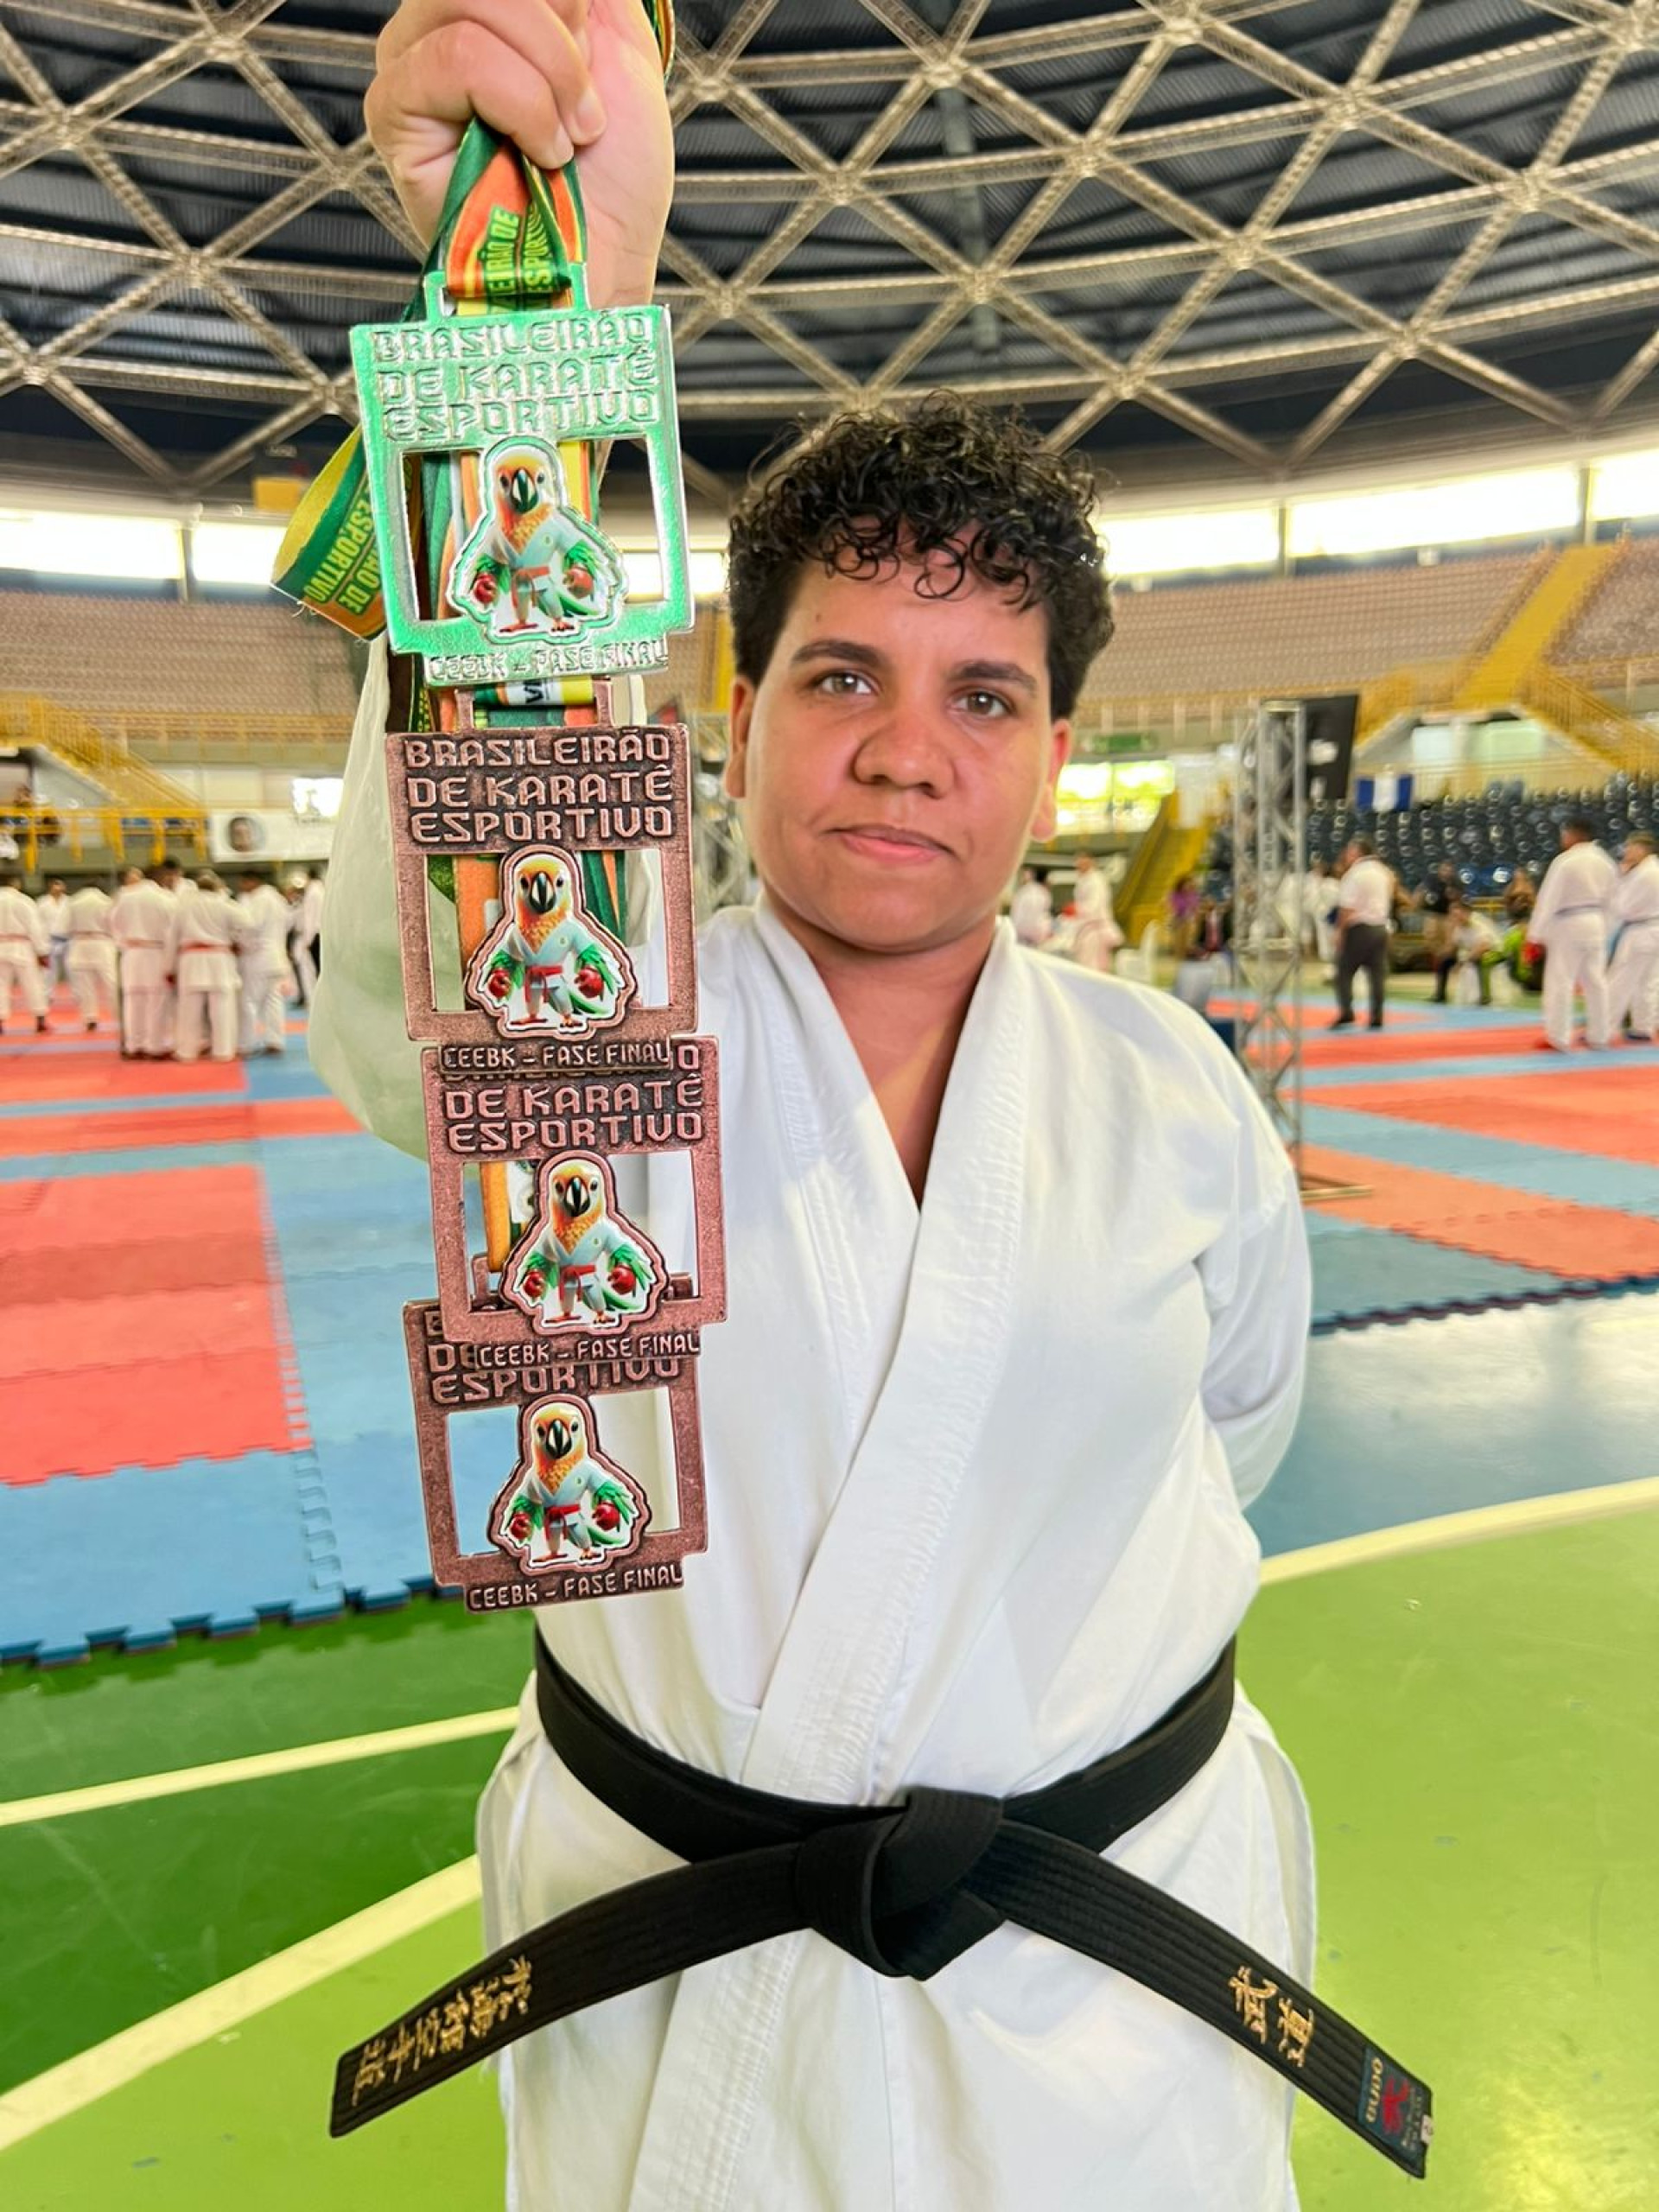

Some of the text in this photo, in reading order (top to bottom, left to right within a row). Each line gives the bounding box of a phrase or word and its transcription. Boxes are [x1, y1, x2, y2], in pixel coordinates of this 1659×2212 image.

[490, 206, 518, 239] DE
[372, 310, 654, 363] BRASILEIRÃO
[378, 344, 660, 404] DE KARATÊ
[383, 388, 659, 442] ESPORTIVO
[338, 584, 371, 614] DE
[404, 729, 670, 768] BRASILEIRÃO
[407, 764, 672, 808] DE KARATÊ
[410, 805, 672, 843] ESPORTIVO
[443, 1046, 516, 1069] CEEBK
[542, 1044, 601, 1066] FASE
[606, 1039, 670, 1063] FINAL
[445, 1071, 702, 1120] DE KARATÊ
[448, 1112, 702, 1153] ESPORTIVO
[480, 1344, 550, 1367] CEEBK
[577, 1338, 632, 1360] FASE
[639, 1332, 700, 1356] FINAL
[469, 1582, 538, 1609] CEEBK
[563, 1573, 617, 1598] FASE
[624, 1564, 683, 1591] FINAL
